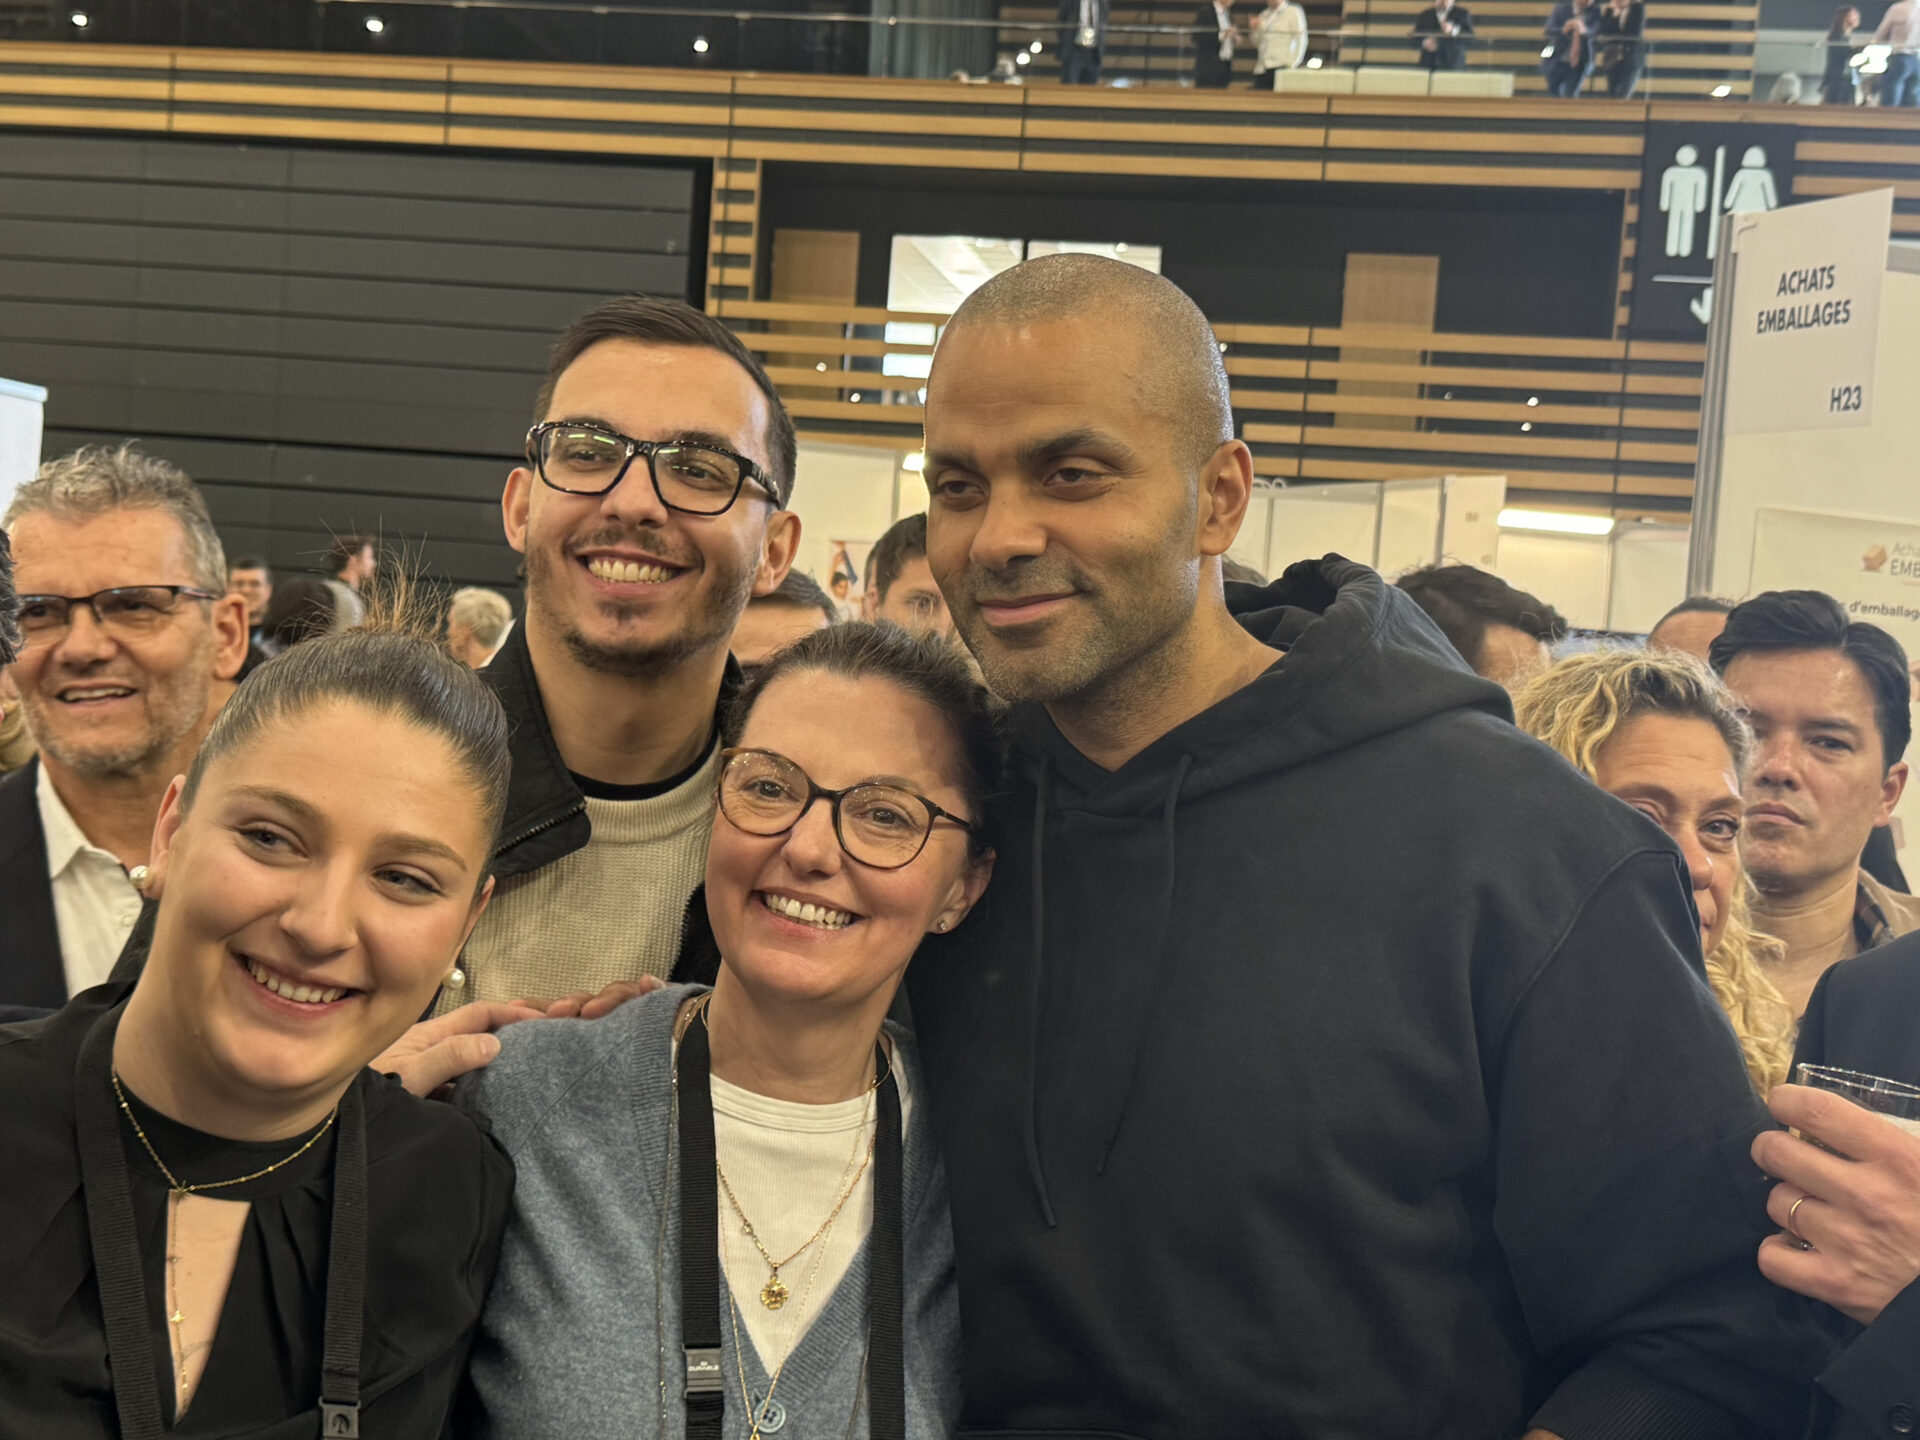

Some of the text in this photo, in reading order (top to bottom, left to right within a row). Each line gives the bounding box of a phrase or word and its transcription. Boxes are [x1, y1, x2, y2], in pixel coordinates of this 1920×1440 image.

[1777, 265, 1835, 296] ACHATS
[1756, 300, 1851, 334] EMBALLAGES
[1830, 386, 1862, 412] H23
[1849, 601, 1920, 621] d'emballag
